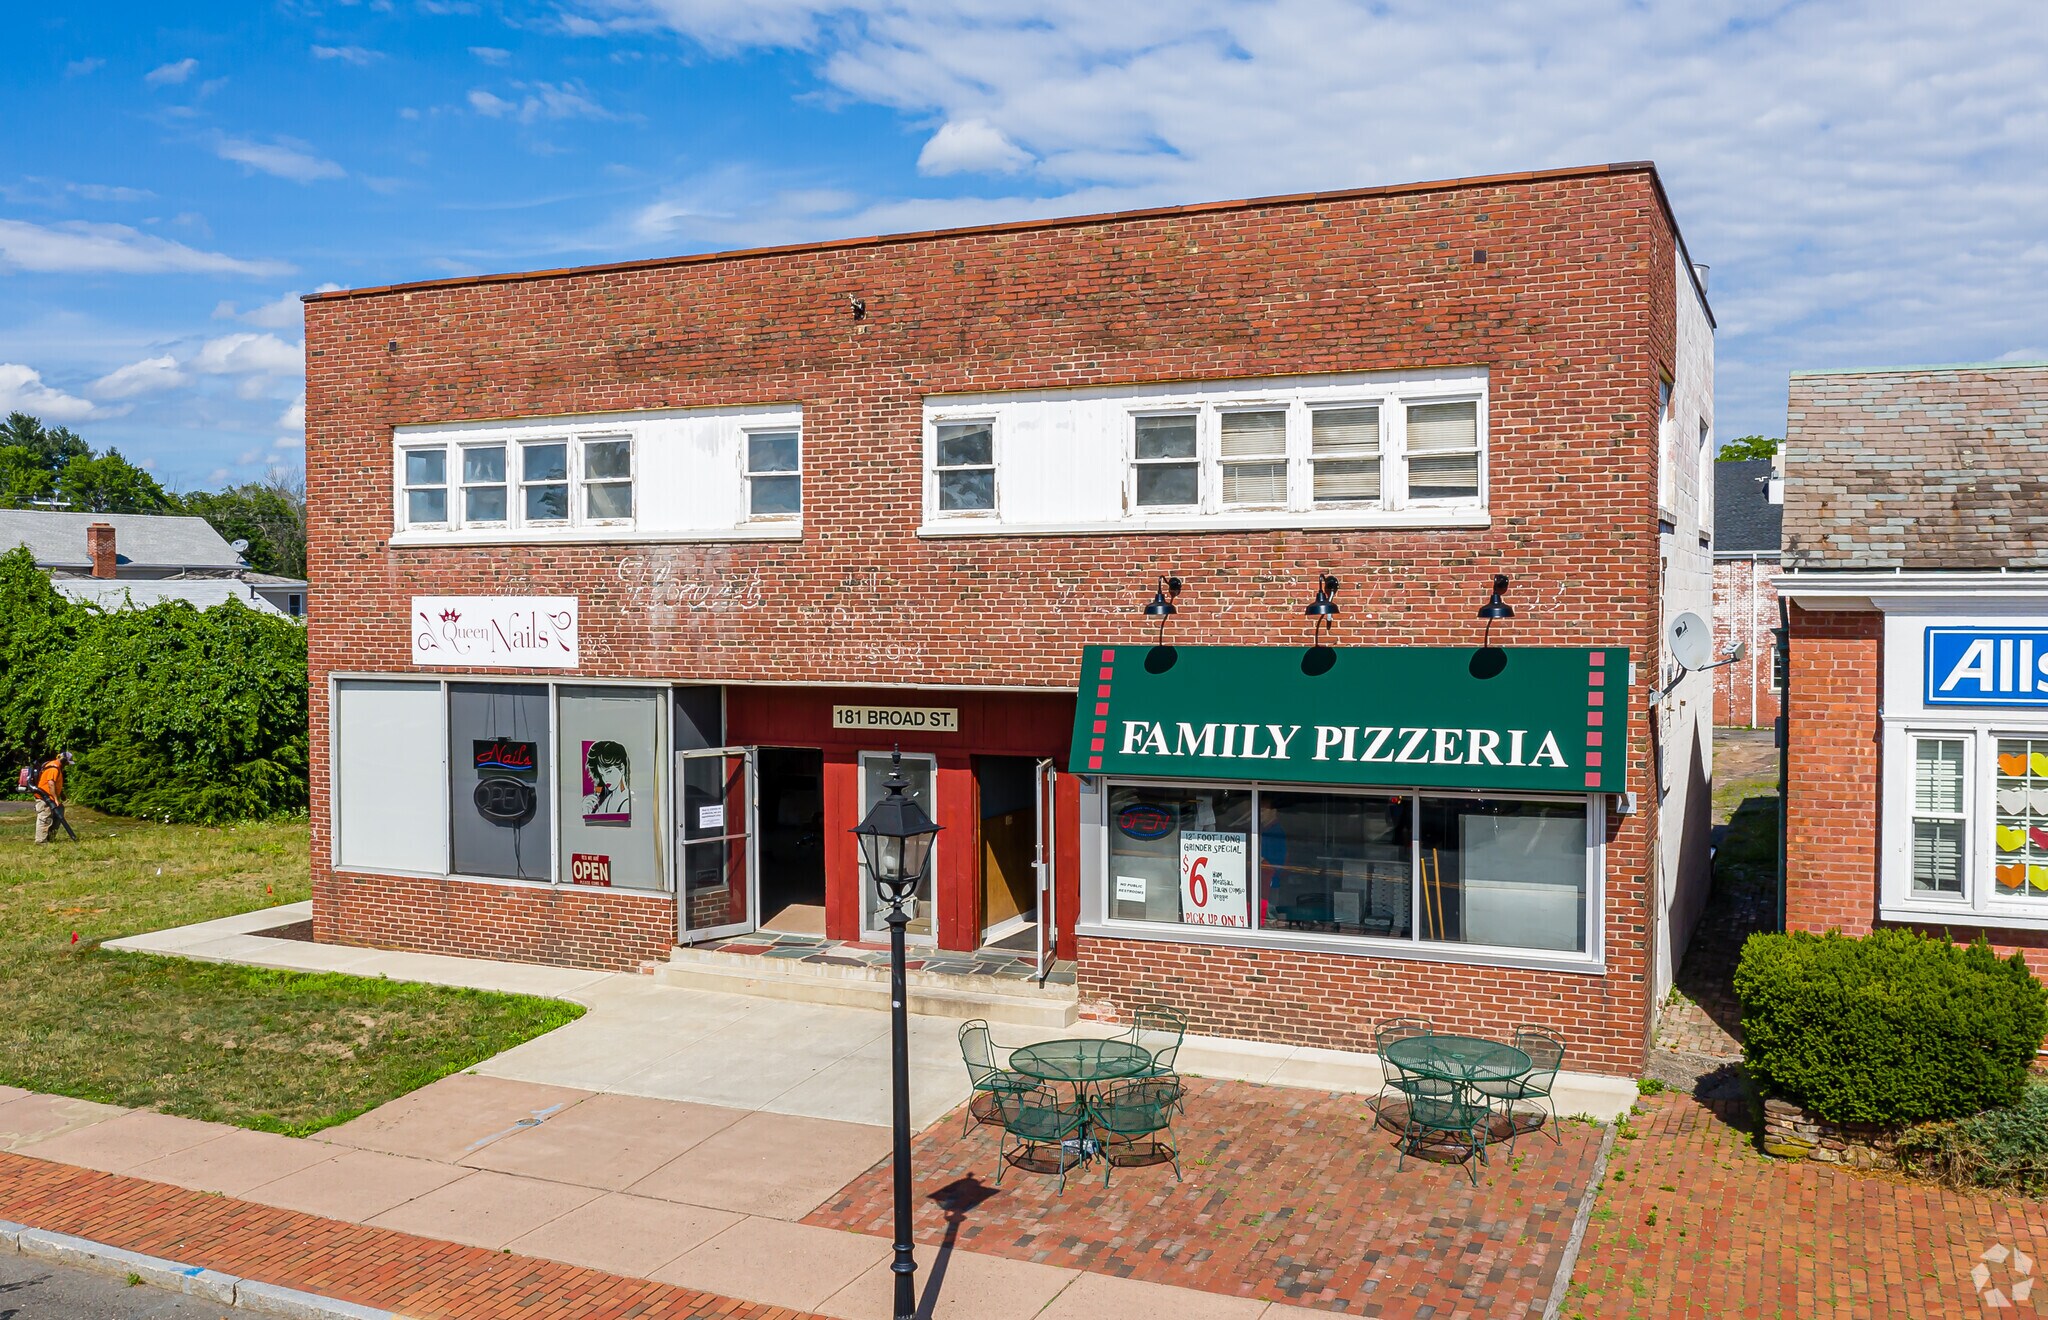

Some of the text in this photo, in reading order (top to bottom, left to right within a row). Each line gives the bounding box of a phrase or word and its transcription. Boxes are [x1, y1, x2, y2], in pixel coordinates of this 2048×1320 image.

[442, 621, 489, 654] Queen
[491, 611, 549, 652] Nails
[836, 709, 955, 727] 181 BROAD ST.
[1119, 720, 1569, 768] FAMILY PIZZERIA
[476, 743, 532, 765] Nails
[476, 786, 530, 810] OPEN
[1120, 813, 1171, 830] OPEN
[1197, 833, 1218, 842] FOOT
[1220, 834, 1241, 844] LONG
[1183, 843, 1242, 854] GRINDER SPECIAL
[573, 861, 608, 881] OPEN
[1185, 912, 1205, 925] PICK
[1207, 913, 1218, 925] UP
